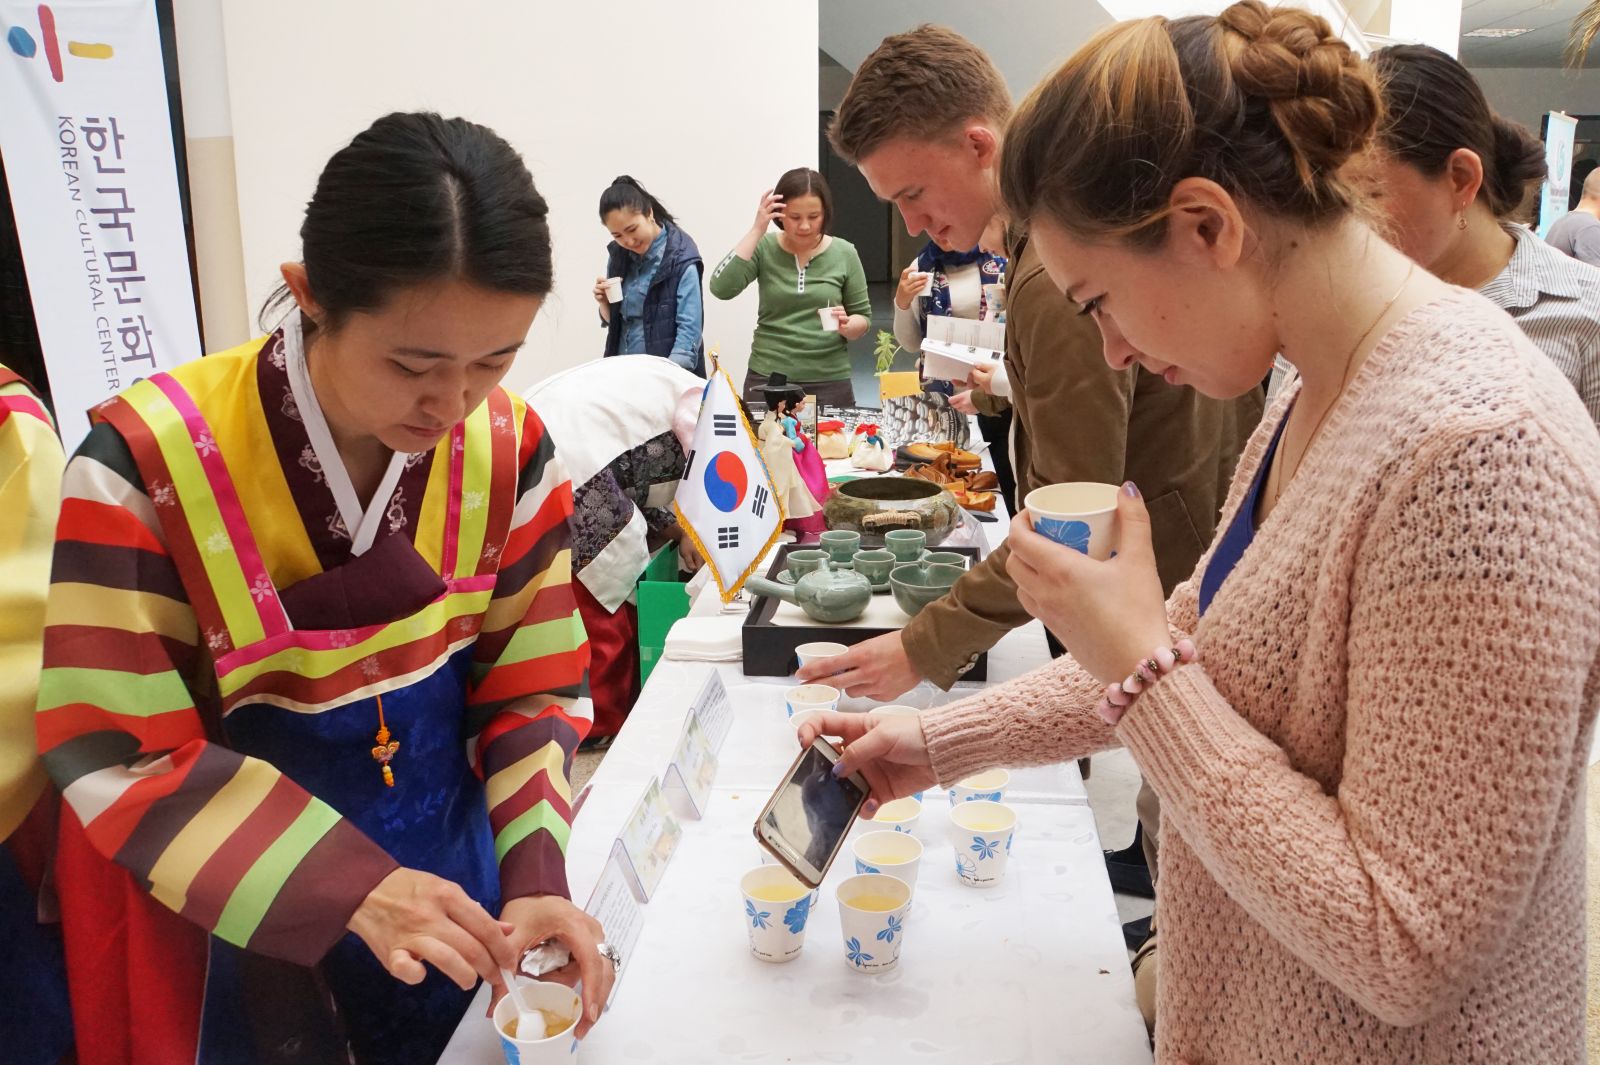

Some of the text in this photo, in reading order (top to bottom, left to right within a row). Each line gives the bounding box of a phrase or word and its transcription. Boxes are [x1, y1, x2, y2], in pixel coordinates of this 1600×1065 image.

[58, 115, 120, 390] KOREAN CULTURAL CENTER
[80, 116, 157, 386] 한국문화
